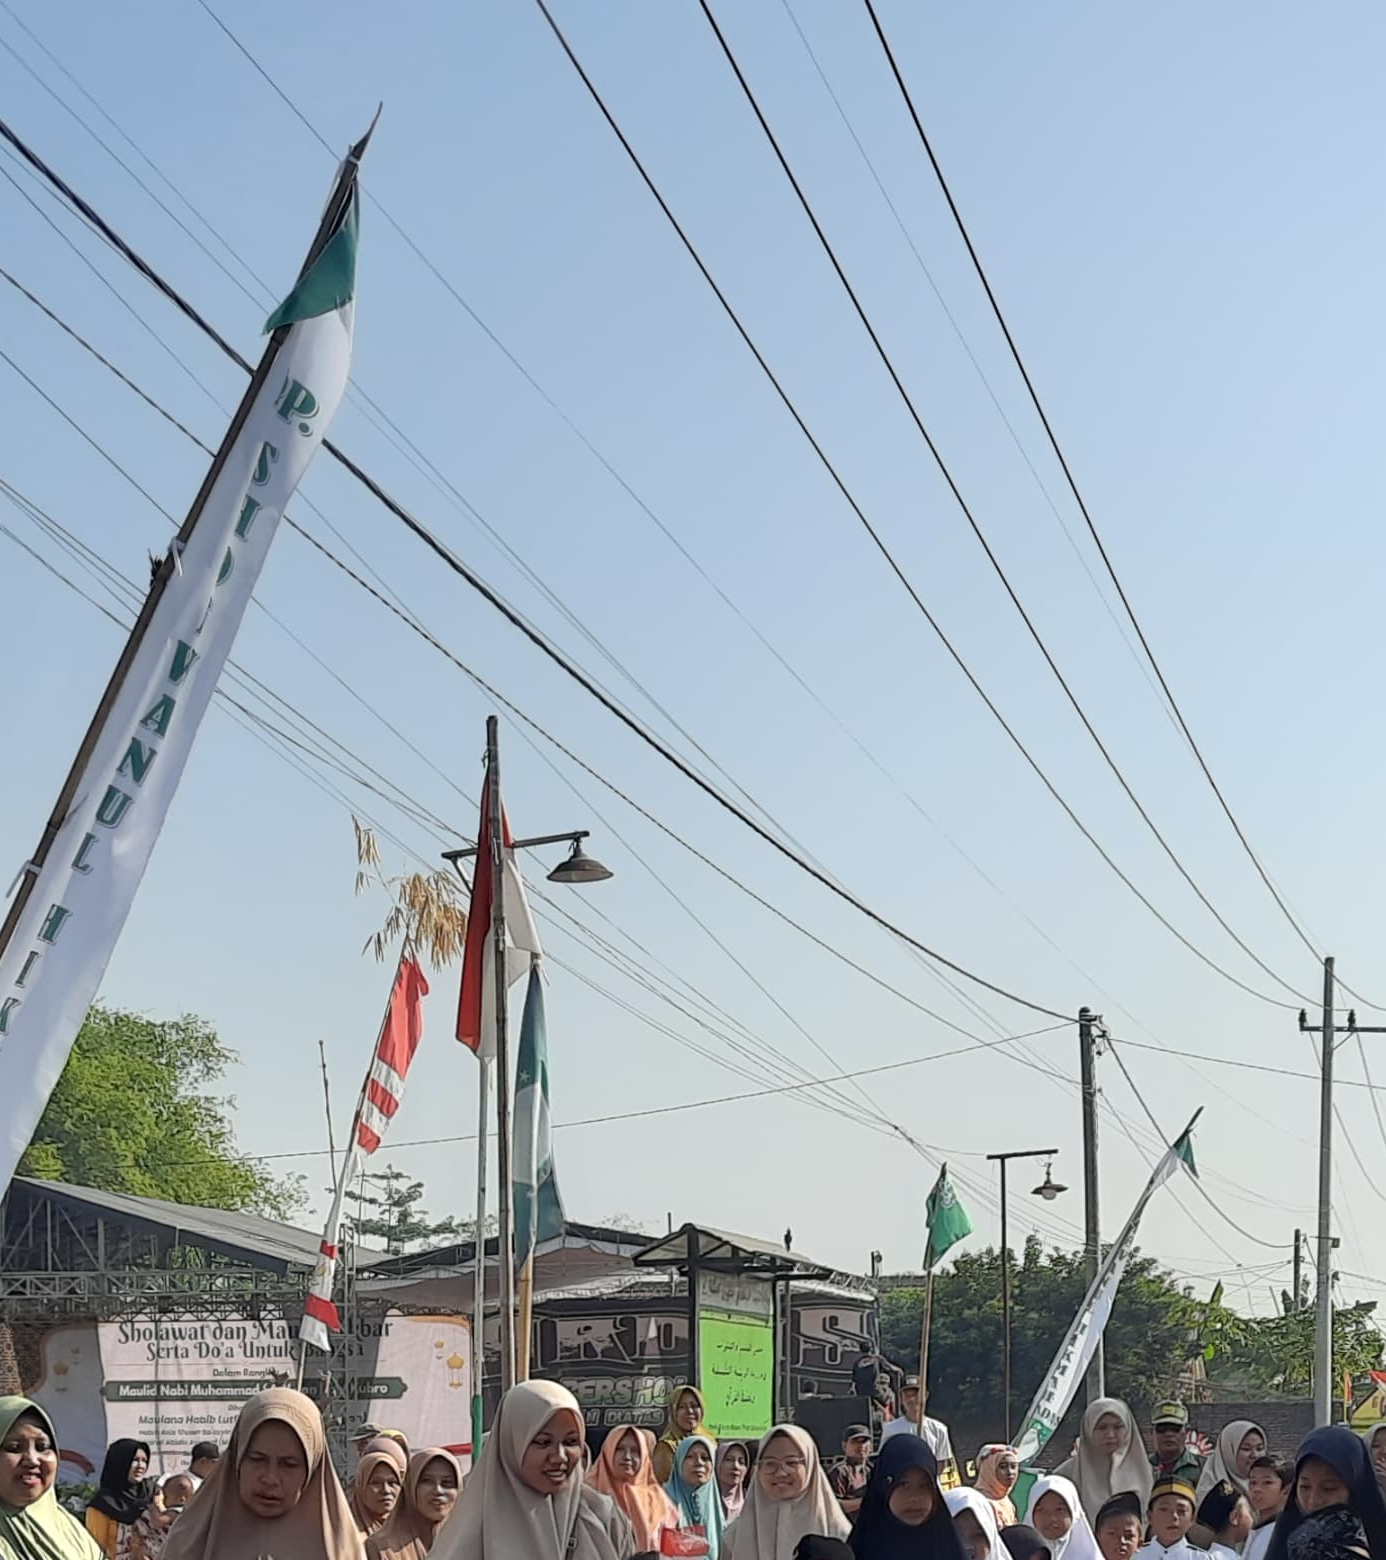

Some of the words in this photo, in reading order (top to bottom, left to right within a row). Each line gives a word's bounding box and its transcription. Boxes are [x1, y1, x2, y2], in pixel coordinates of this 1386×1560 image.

[118, 1321, 209, 1345] Sholawat
[213, 1321, 247, 1344] dan
[146, 1342, 190, 1362] Serta
[237, 1341, 298, 1361] Untuk
[212, 1368, 242, 1377] Dalam
[118, 1384, 158, 1397] Maulid
[160, 1384, 188, 1397] Nabi
[190, 1384, 260, 1397] Muhammad
[186, 1414, 216, 1425] Habib
